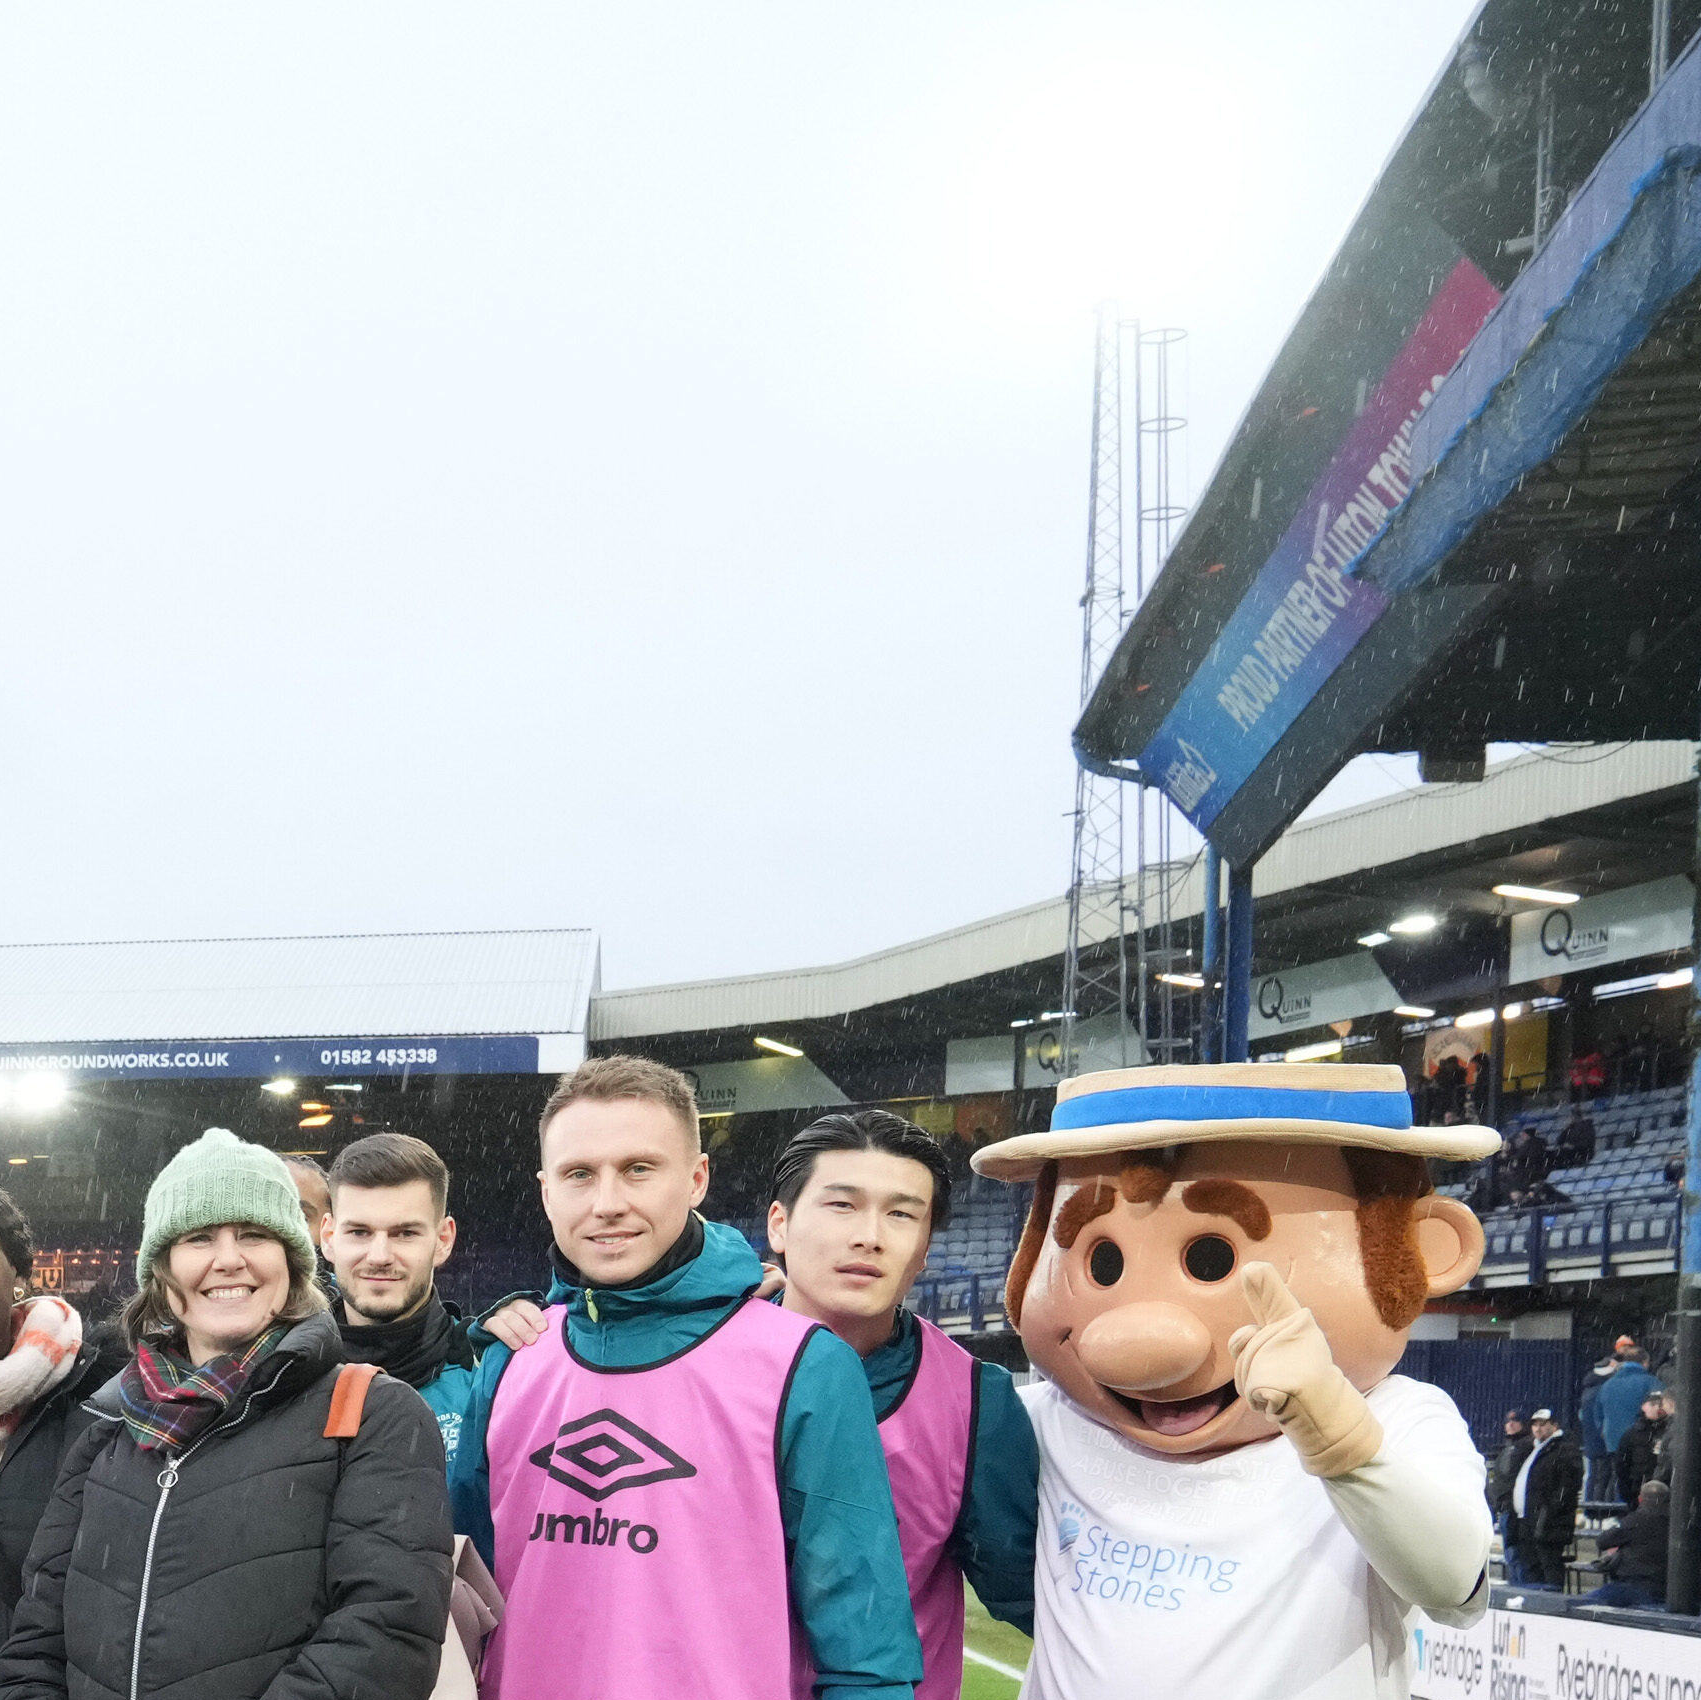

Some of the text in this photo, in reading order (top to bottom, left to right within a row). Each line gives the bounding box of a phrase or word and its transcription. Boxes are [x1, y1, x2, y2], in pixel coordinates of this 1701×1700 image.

[1540, 908, 1609, 961] QUINN
[1258, 975, 1312, 1024] QUINN
[320, 1048, 371, 1066] 01582
[375, 1046, 438, 1065] 453338
[1071, 1559, 1186, 1611] Stones
[1078, 1525, 1242, 1593] Stepping
[1424, 1631, 1483, 1695] ryebridge
